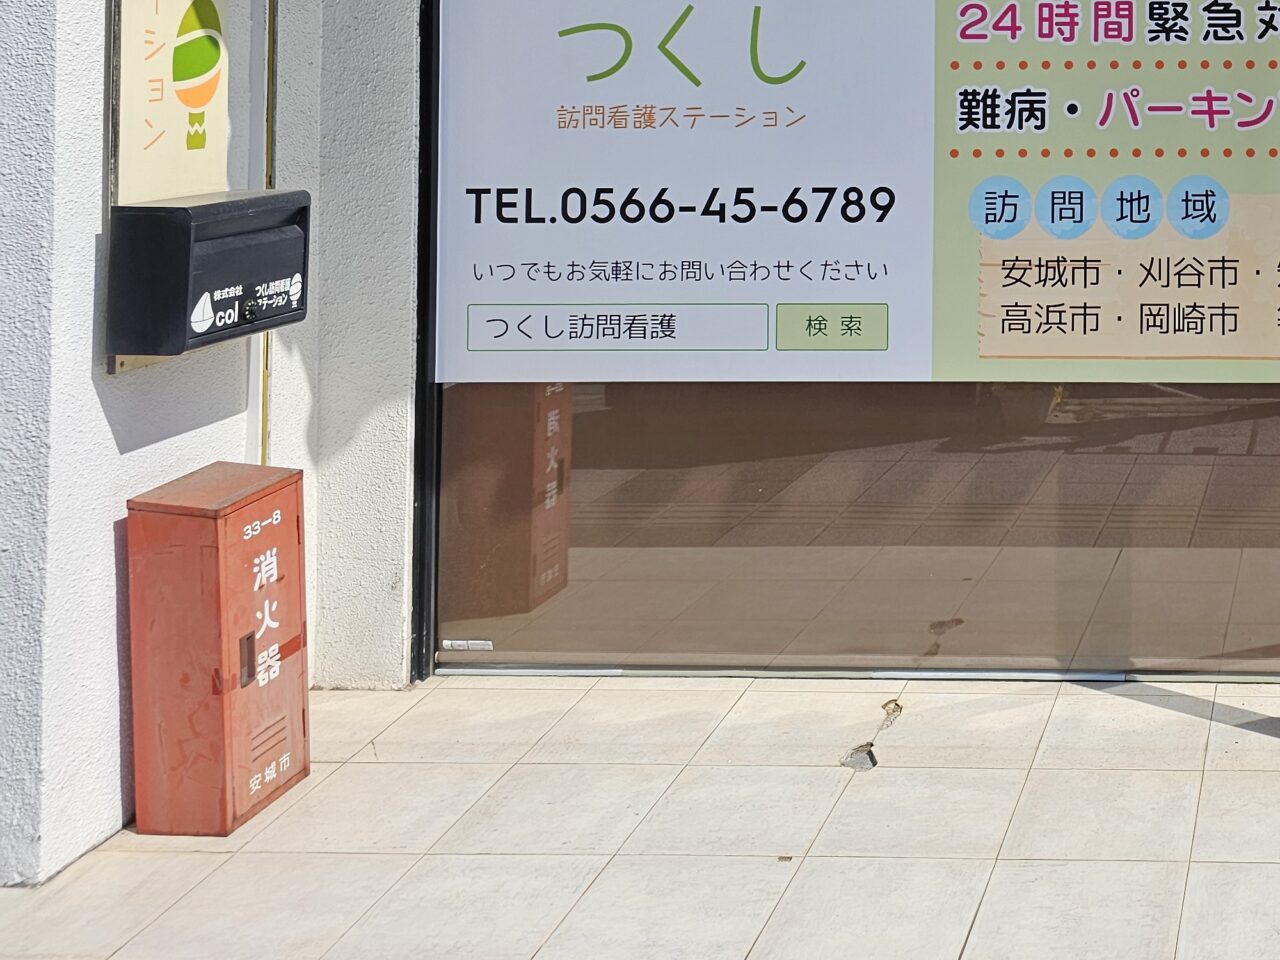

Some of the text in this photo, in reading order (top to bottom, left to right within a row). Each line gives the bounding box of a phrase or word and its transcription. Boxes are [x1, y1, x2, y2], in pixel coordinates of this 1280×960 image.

[558, 4, 807, 87] つくし
[557, 104, 806, 129] 訪問看護ステーション
[466, 186, 896, 225] TEL.0566-45-6789
[473, 260, 889, 283] いつでもお気軽にお問い合わせください
[214, 285, 243, 302] 株式会社
[216, 301, 239, 327] col
[485, 313, 677, 340] つくし訪問看護
[805, 314, 863, 337] 検索
[243, 510, 281, 540] 33-8
[253, 547, 281, 687] 消火器
[249, 752, 291, 795] 安城市
